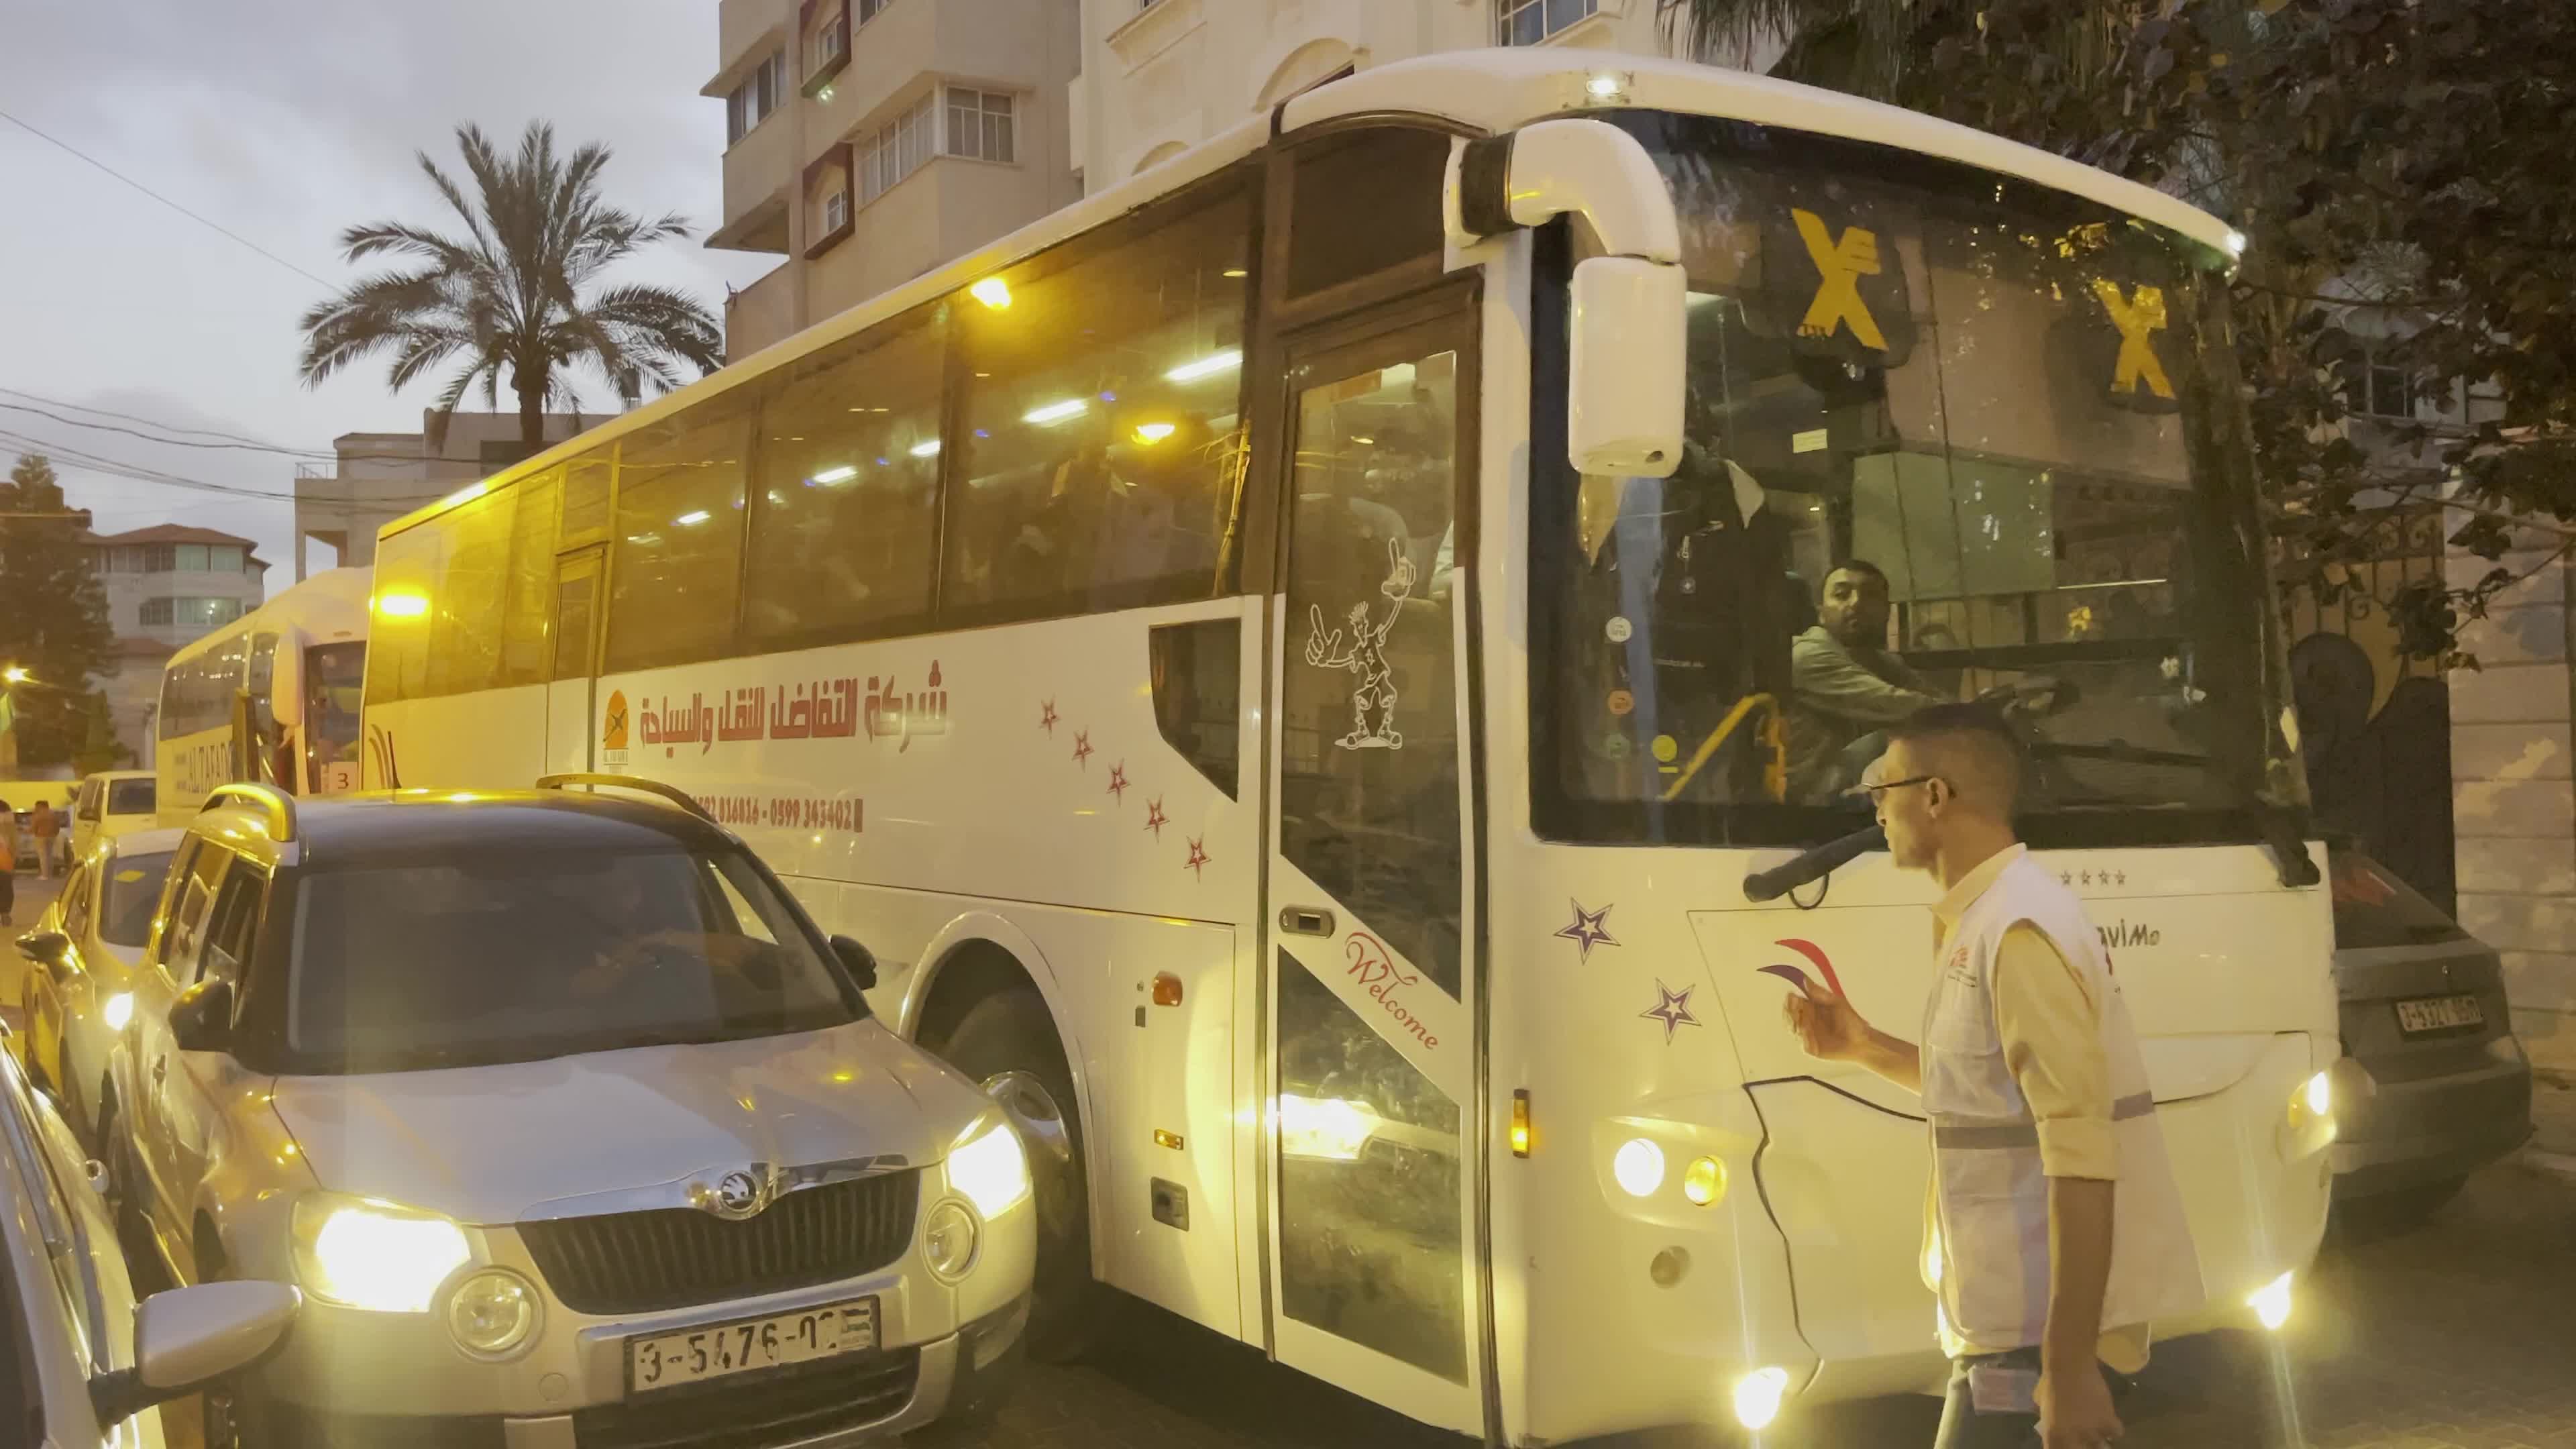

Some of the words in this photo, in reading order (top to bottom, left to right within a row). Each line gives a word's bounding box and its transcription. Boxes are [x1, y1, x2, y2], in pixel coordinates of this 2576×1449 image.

[640, 692, 714, 759] والسياحة
[718, 686, 765, 741] للنقل
[770, 678, 857, 739] التفاضل
[865, 660, 948, 753] شركة
[337, 772, 350, 790] 3
[770, 798, 800, 827] 0599
[803, 799, 852, 830] 343402
[1345, 932, 1438, 1050] Welcome
